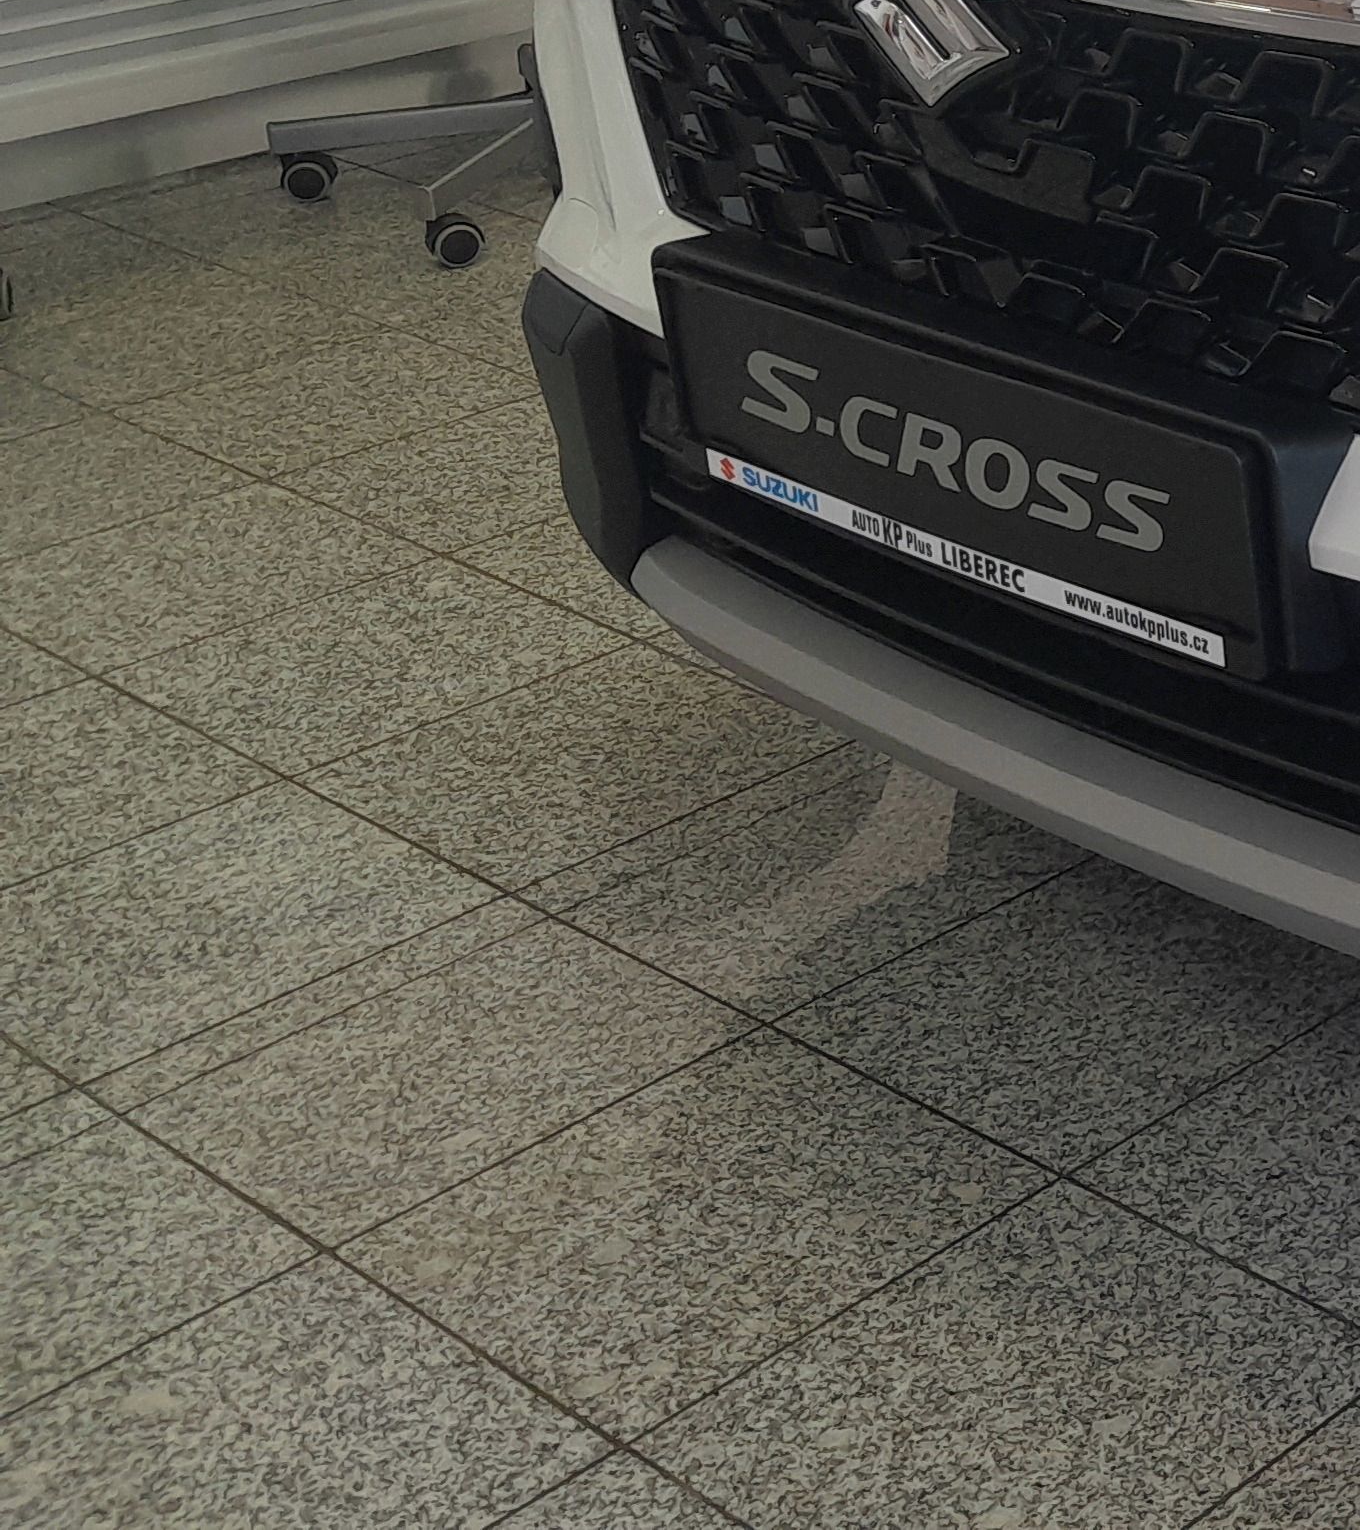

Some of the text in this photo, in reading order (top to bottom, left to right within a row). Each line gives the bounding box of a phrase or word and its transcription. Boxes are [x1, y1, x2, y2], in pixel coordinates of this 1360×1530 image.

[742, 466, 1210, 655] SUZUKI AUTO KP Plus LIBEREC www.autokpplus.cz
